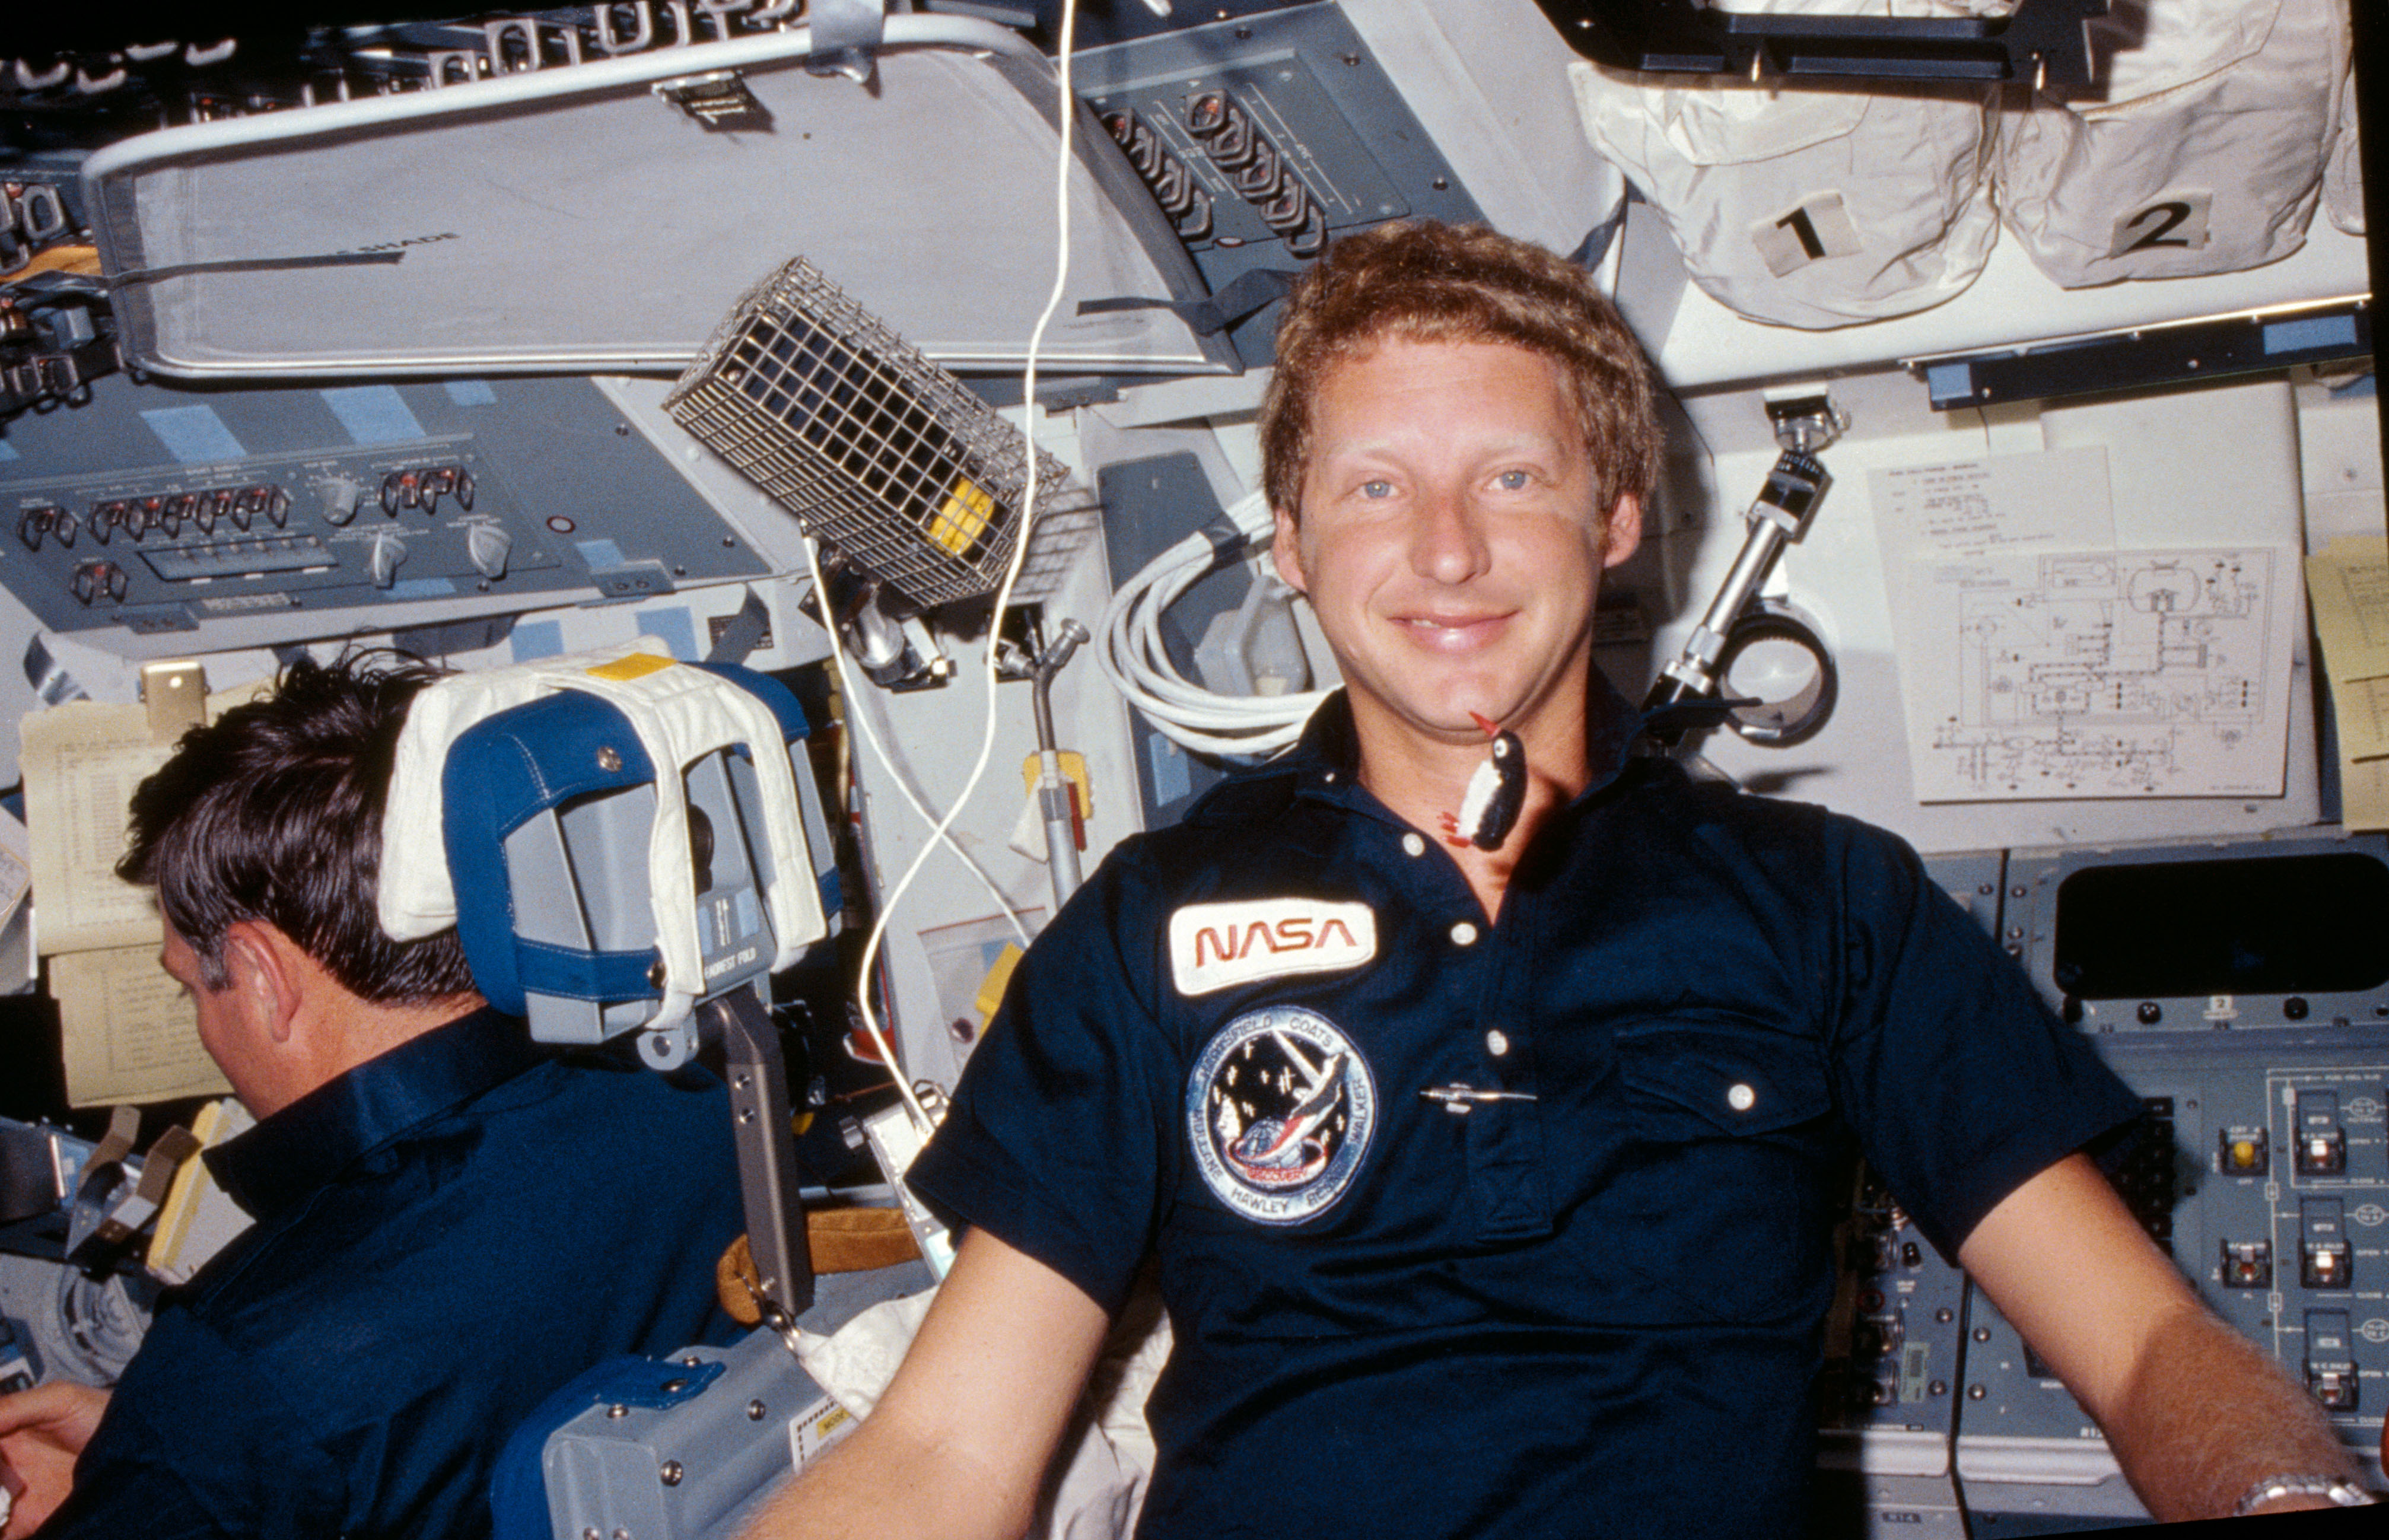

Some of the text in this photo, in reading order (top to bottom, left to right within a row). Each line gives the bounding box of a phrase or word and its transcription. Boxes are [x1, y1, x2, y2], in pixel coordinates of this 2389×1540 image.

[1775, 206, 1826, 258] 1
[2126, 202, 2191, 247] 2
[1195, 918, 1357, 968] NASA
[1289, 1016, 1334, 1048] COATS
[1347, 1078, 1368, 1146] WALKER
[1192, 1108, 1224, 1181] MULLANE
[1231, 1187, 1290, 1214] HAWLEY
